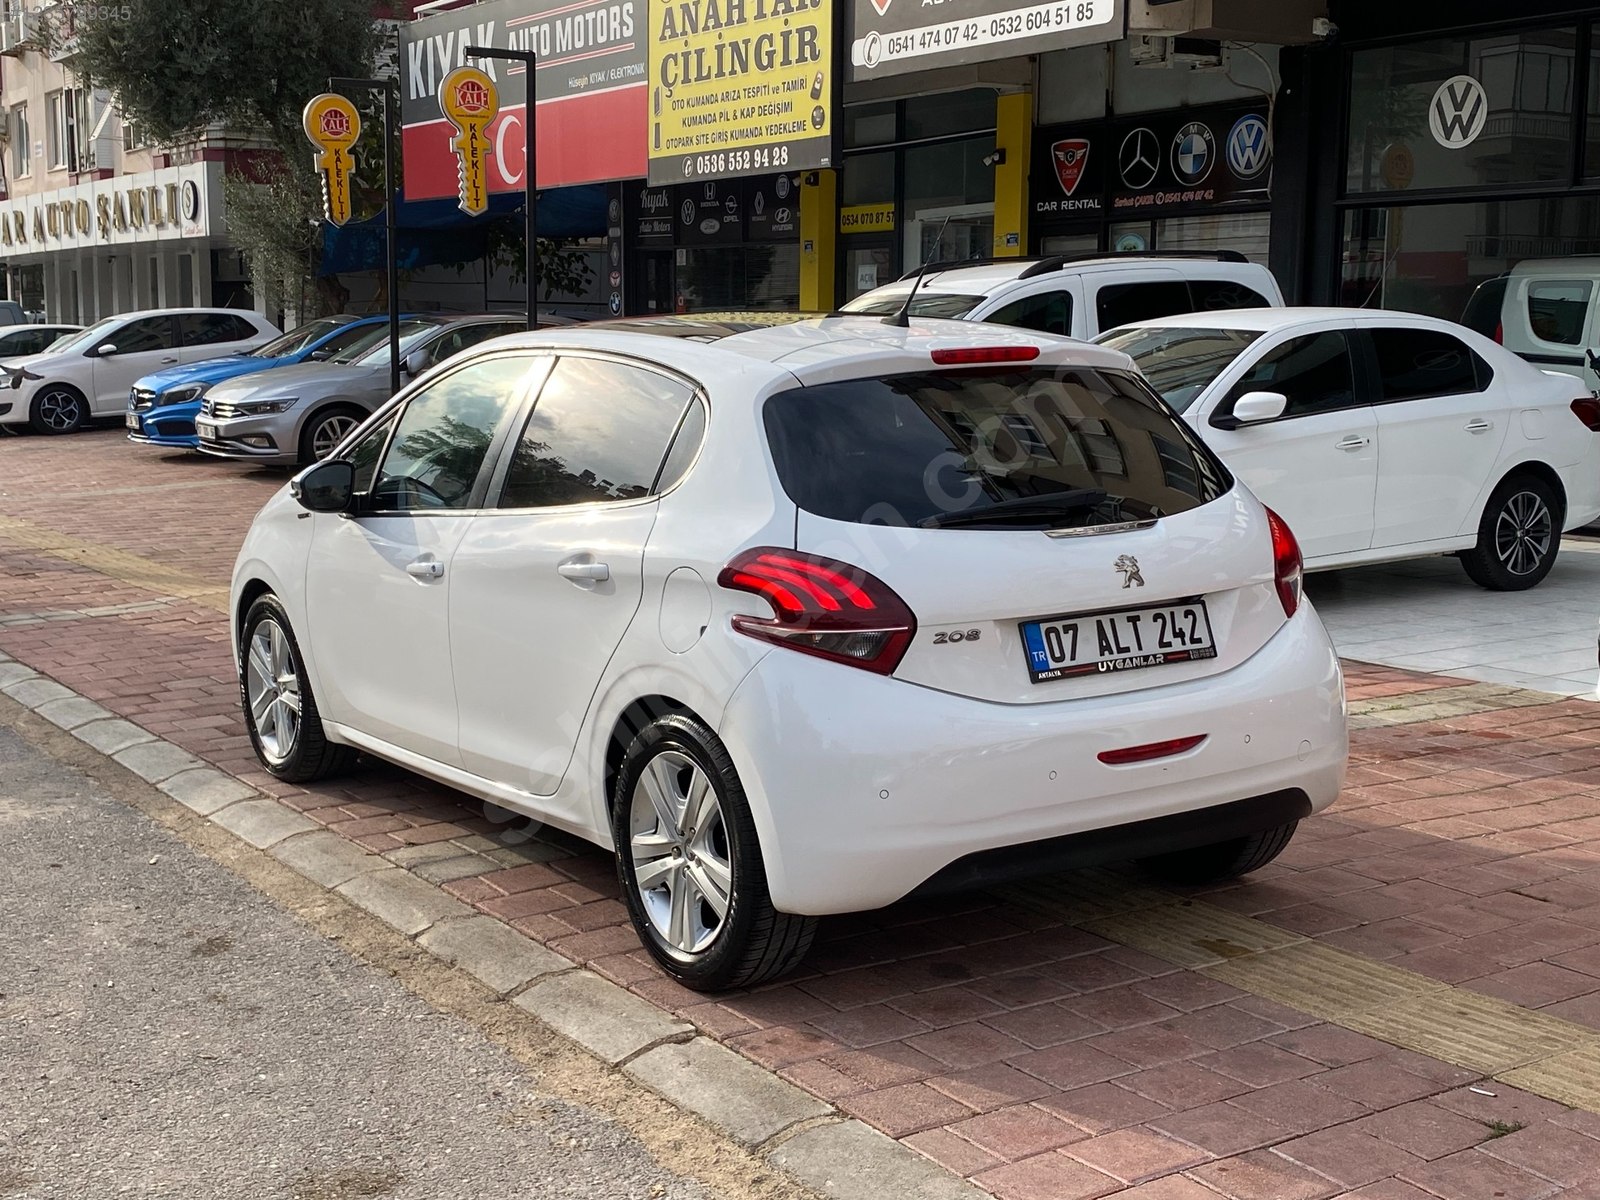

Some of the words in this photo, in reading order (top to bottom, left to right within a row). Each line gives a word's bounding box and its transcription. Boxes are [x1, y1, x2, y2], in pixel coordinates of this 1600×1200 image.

[507, 23, 550, 64] AUTO
[556, 2, 634, 53] MOTORS
[888, 35, 916, 55] 0541
[919, 31, 941, 49] 474
[944, 28, 959, 45] 07
[963, 23, 978, 41] 42
[990, 15, 1022, 37] 0532
[1026, 10, 1051, 30] 604
[1055, 5, 1072, 25] 51
[1076, 1, 1094, 22] 85
[661, 18, 821, 98] ÇİLİNGİR
[568, 75, 589, 89] Hüseyin
[671, 100, 685, 111] OTO
[686, 93, 719, 109] KUMANDA
[720, 89, 741, 102] ARIZA
[771, 86, 780, 95] ve
[781, 75, 808, 93] TAMİRİ
[455, 87, 489, 108] KALE
[320, 115, 351, 133] KALE
[681, 112, 717, 128] KUMANDA
[718, 108, 730, 122] PİL
[739, 105, 756, 120] KAP
[665, 137, 694, 150] OTOPARK
[729, 125, 763, 142] KUMANDA
[764, 119, 807, 137] YEDEKLEME
[696, 156, 724, 175] 0536
[728, 151, 750, 171] 552
[754, 149, 769, 169] 94
[772, 145, 789, 166] 28
[1037, 201, 1057, 212] CAR
[1061, 198, 1101, 211] RENTAL
[33, 197, 90, 243] AUTO
[842, 215, 859, 226] 0534
[860, 213, 874, 224] 070
[875, 212, 885, 223] 87
[886, 210, 895, 222] 57
[932, 629, 982, 645] 208
[1045, 623, 1079, 663] 07
[1096, 614, 1143, 657] ALT
[1152, 609, 1203, 649] 242
[1033, 651, 1047, 662] TR
[1038, 669, 1062, 679] ANTALYA
[1098, 654, 1164, 672] UYGANLAR
